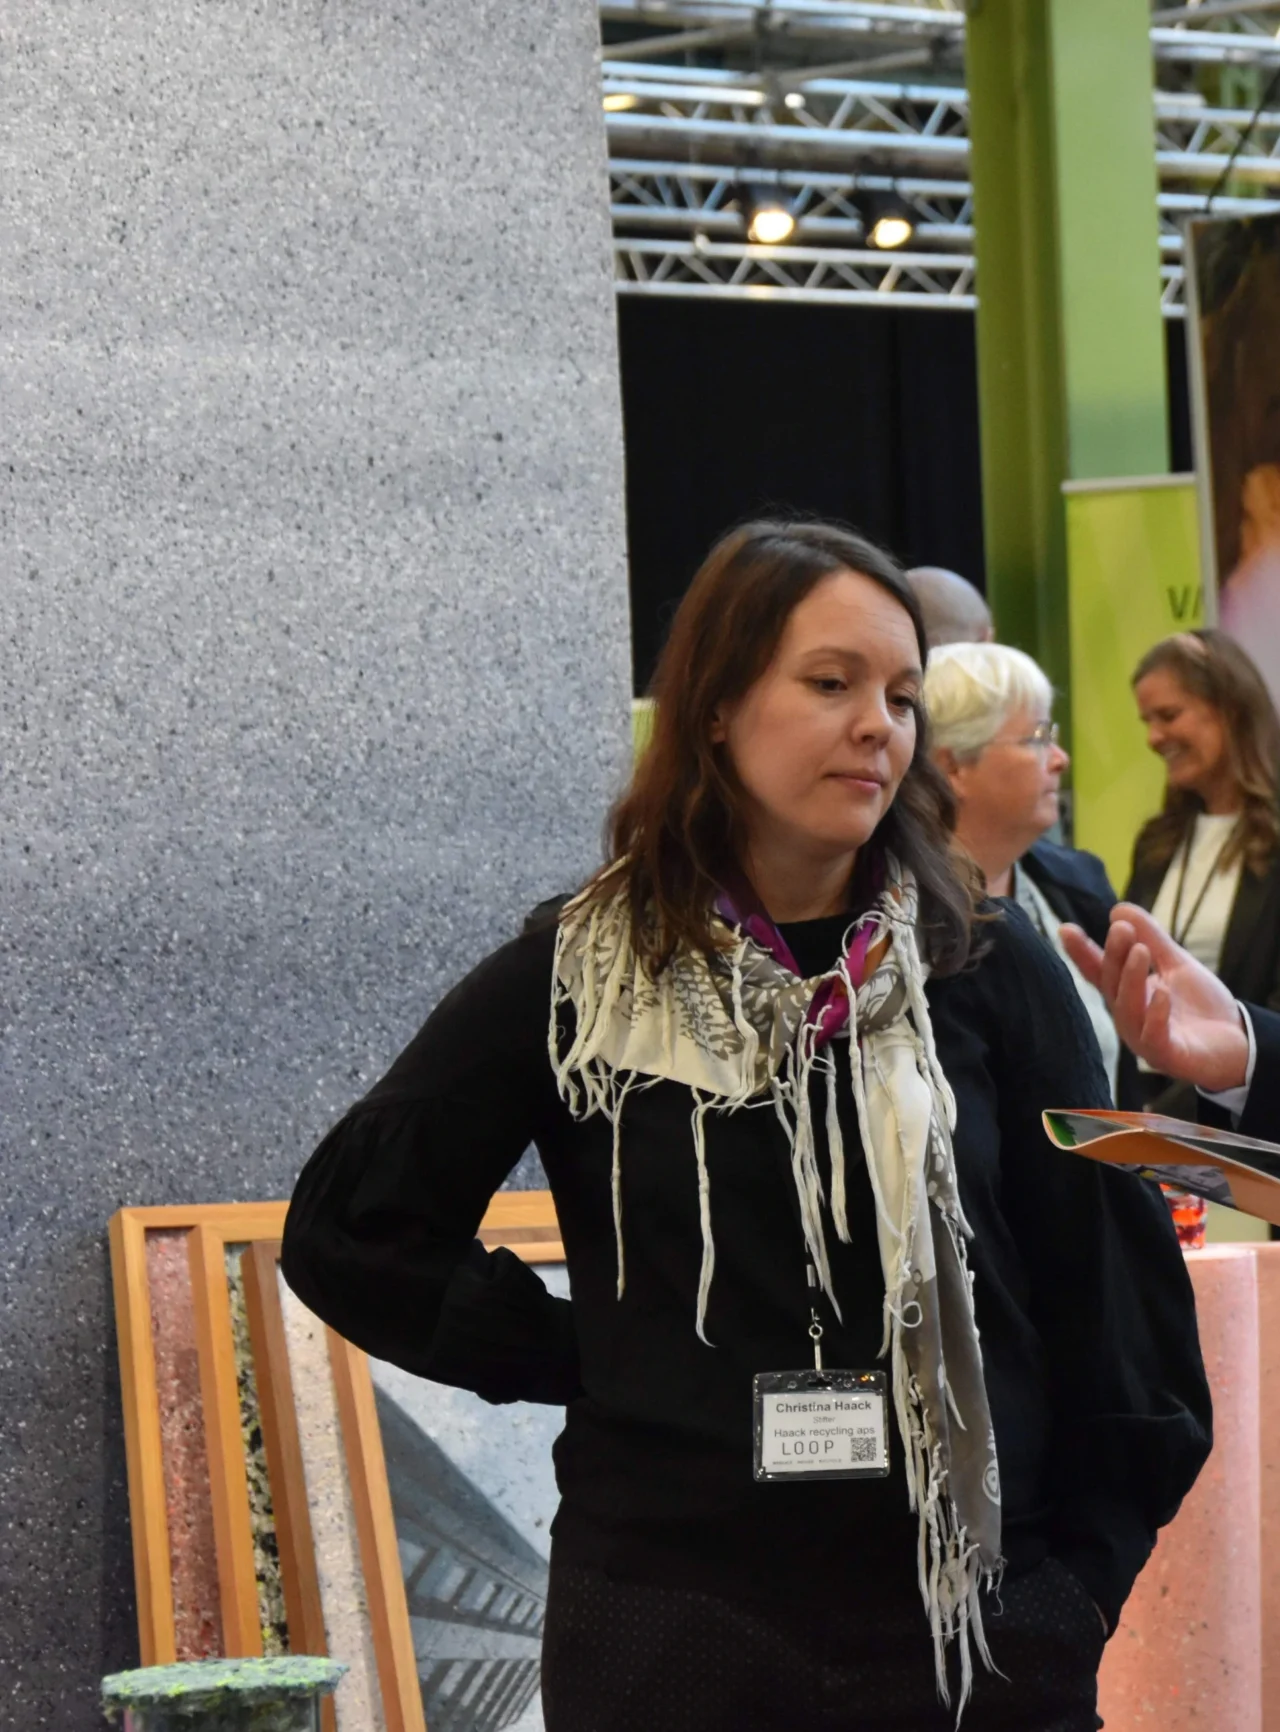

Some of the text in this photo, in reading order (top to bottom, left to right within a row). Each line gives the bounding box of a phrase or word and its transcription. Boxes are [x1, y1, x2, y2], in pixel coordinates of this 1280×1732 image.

[776, 1400, 872, 1413] Christina Haack
[774, 1426, 875, 1438] Haack recycling aps
[782, 1440, 834, 1455] LOOP
